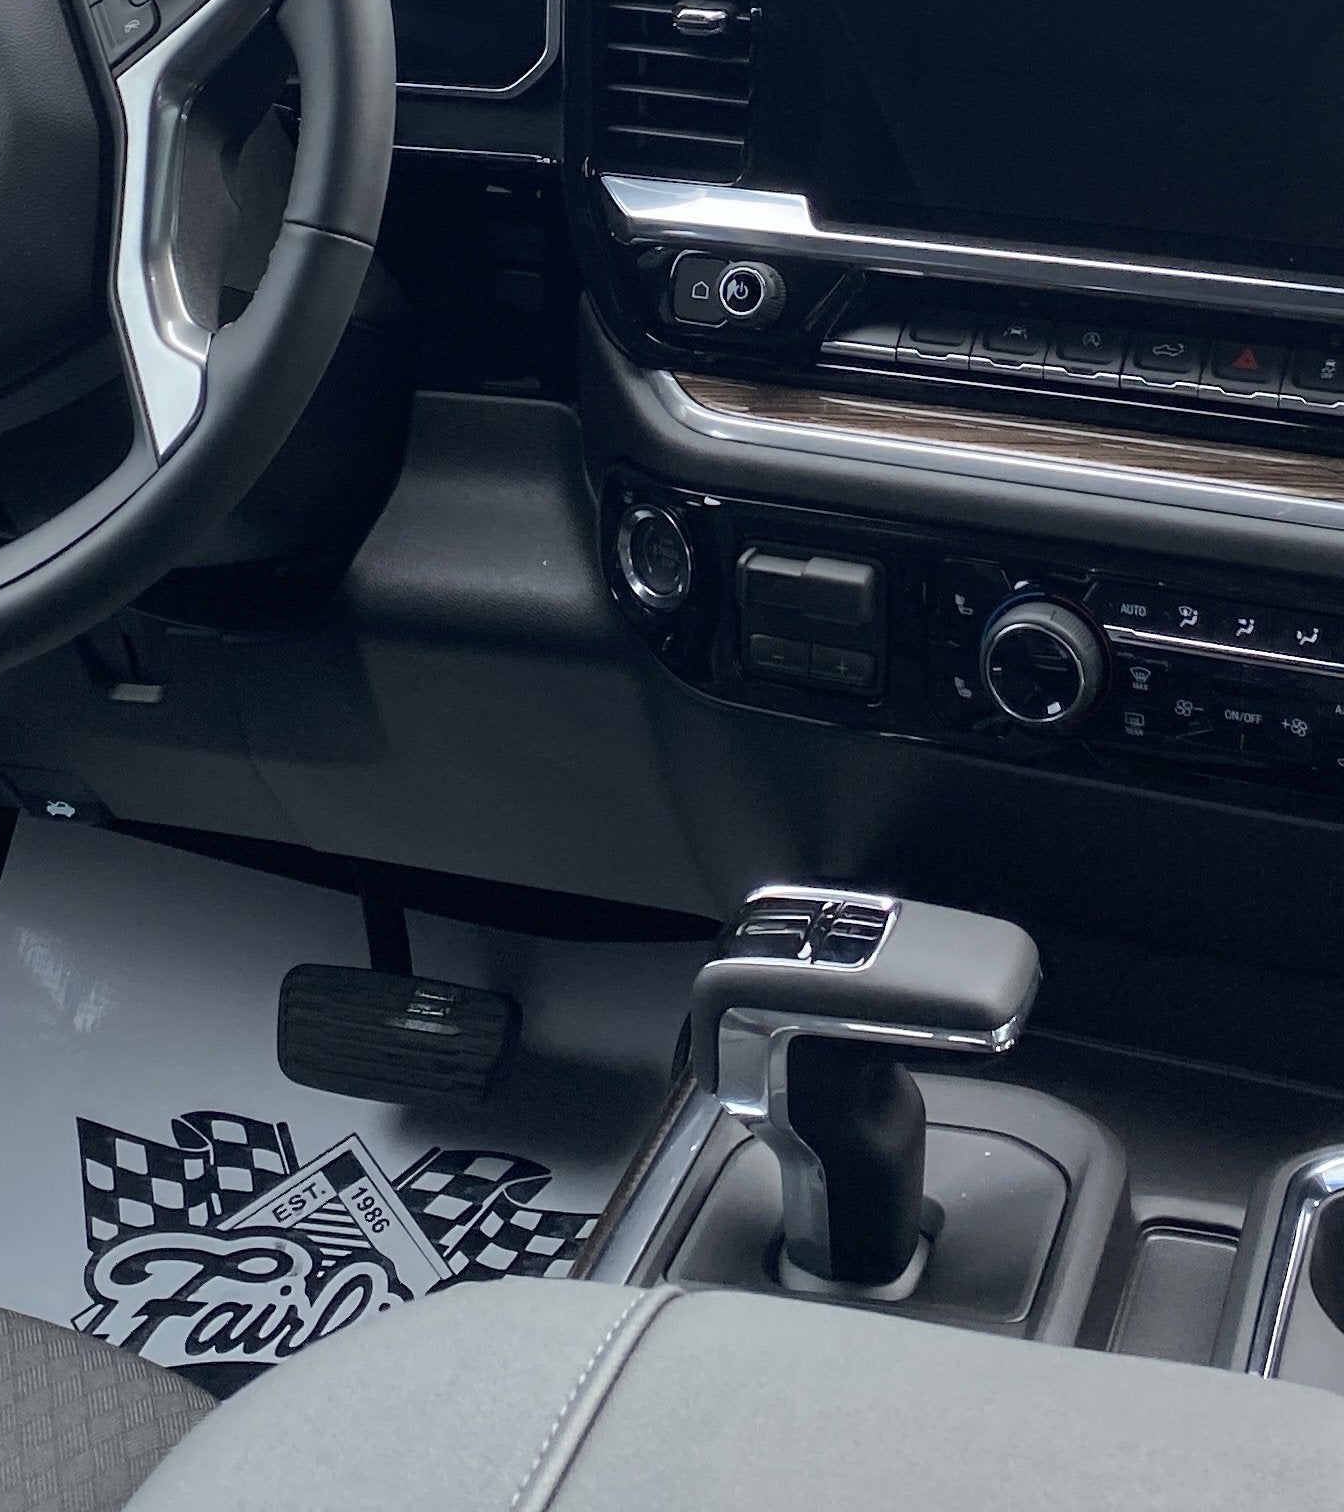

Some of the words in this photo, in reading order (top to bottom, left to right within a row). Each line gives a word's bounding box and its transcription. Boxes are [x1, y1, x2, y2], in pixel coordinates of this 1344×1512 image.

[1119, 602, 1148, 618] AUTO
[1224, 708, 1263, 726] ON/OFF
[271, 1180, 328, 1224] EST.
[350, 1185, 391, 1234] 1986
[109, 1246, 393, 1359] Fairl
